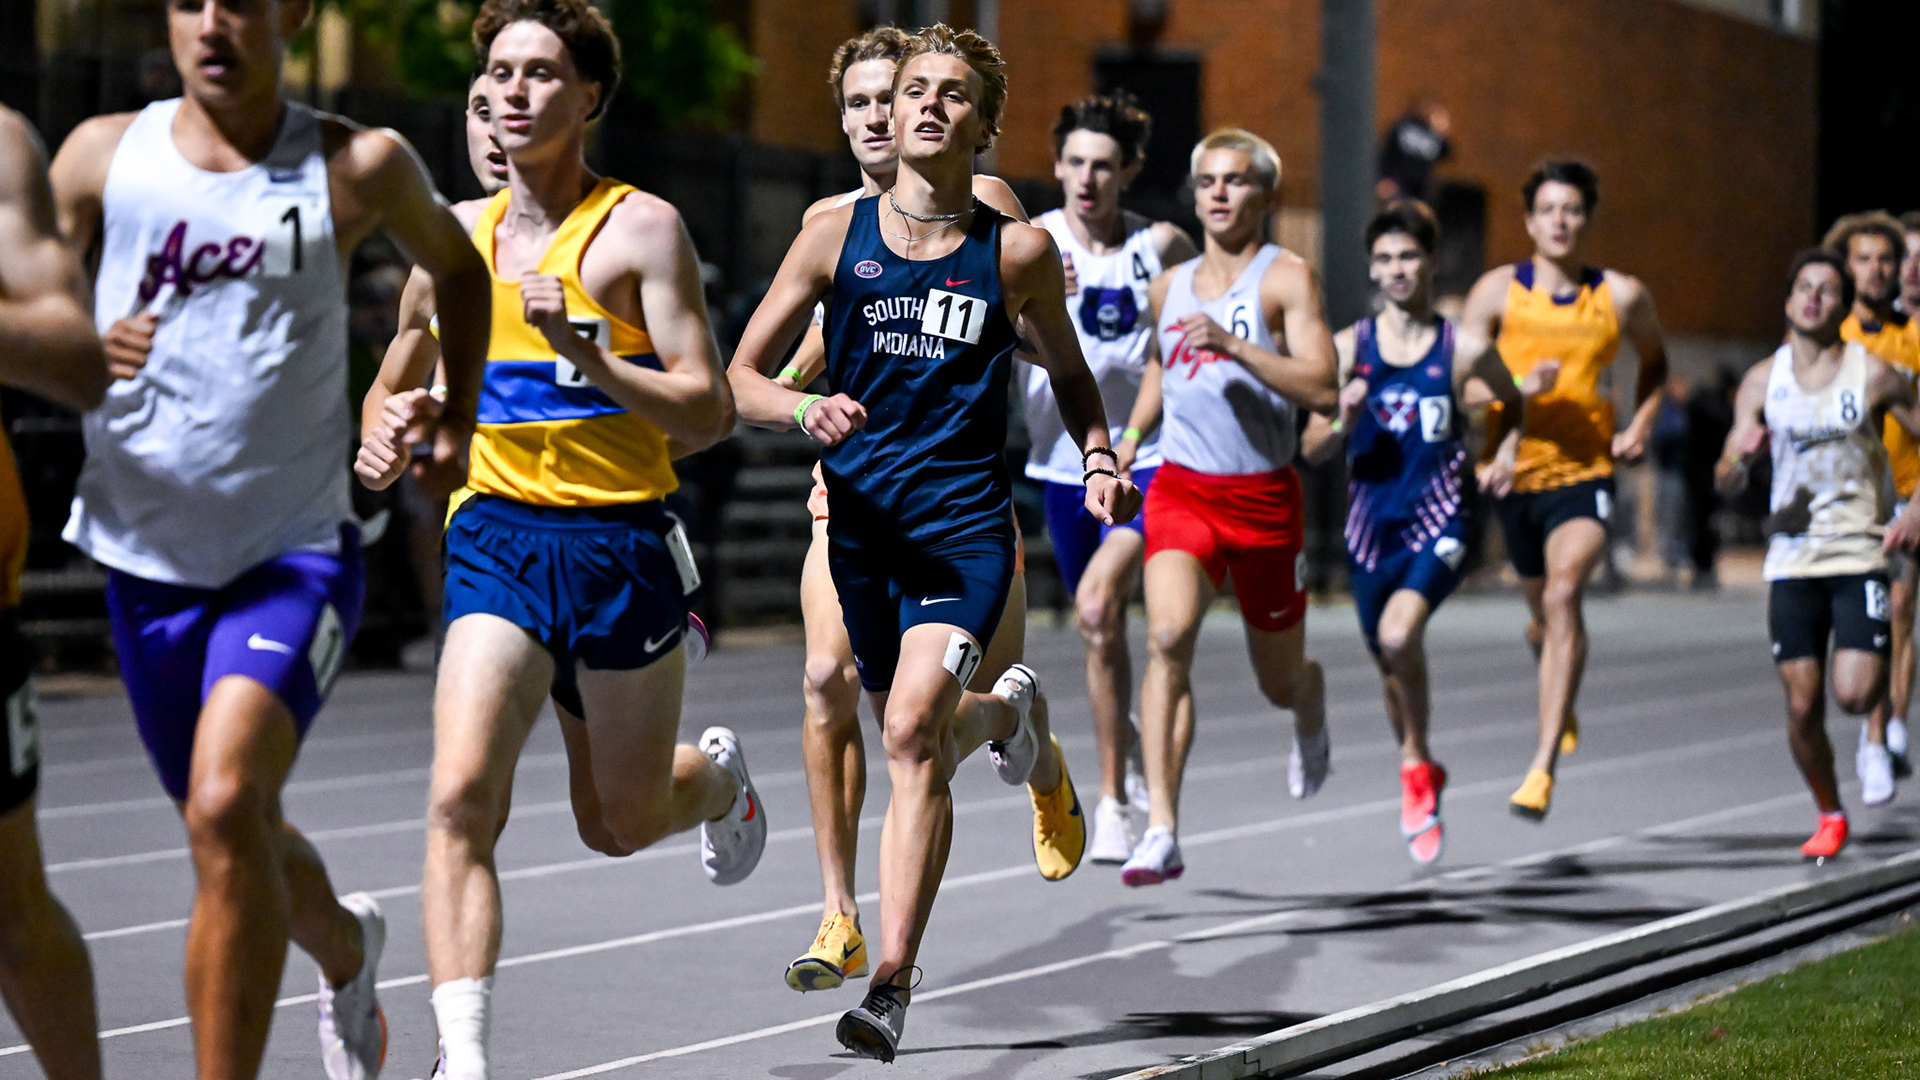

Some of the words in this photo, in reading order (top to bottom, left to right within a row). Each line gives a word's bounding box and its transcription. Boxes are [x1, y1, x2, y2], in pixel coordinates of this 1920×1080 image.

[280, 205, 302, 271] 1
[139, 220, 266, 301] Ace
[1132, 252, 1151, 284] 4
[862, 296, 926, 326] SOUTH
[937, 294, 974, 339] 11
[1231, 304, 1250, 341] 6
[873, 331, 946, 360] INDIANA
[1841, 390, 1858, 422] 8
[954, 640, 980, 688] 11
